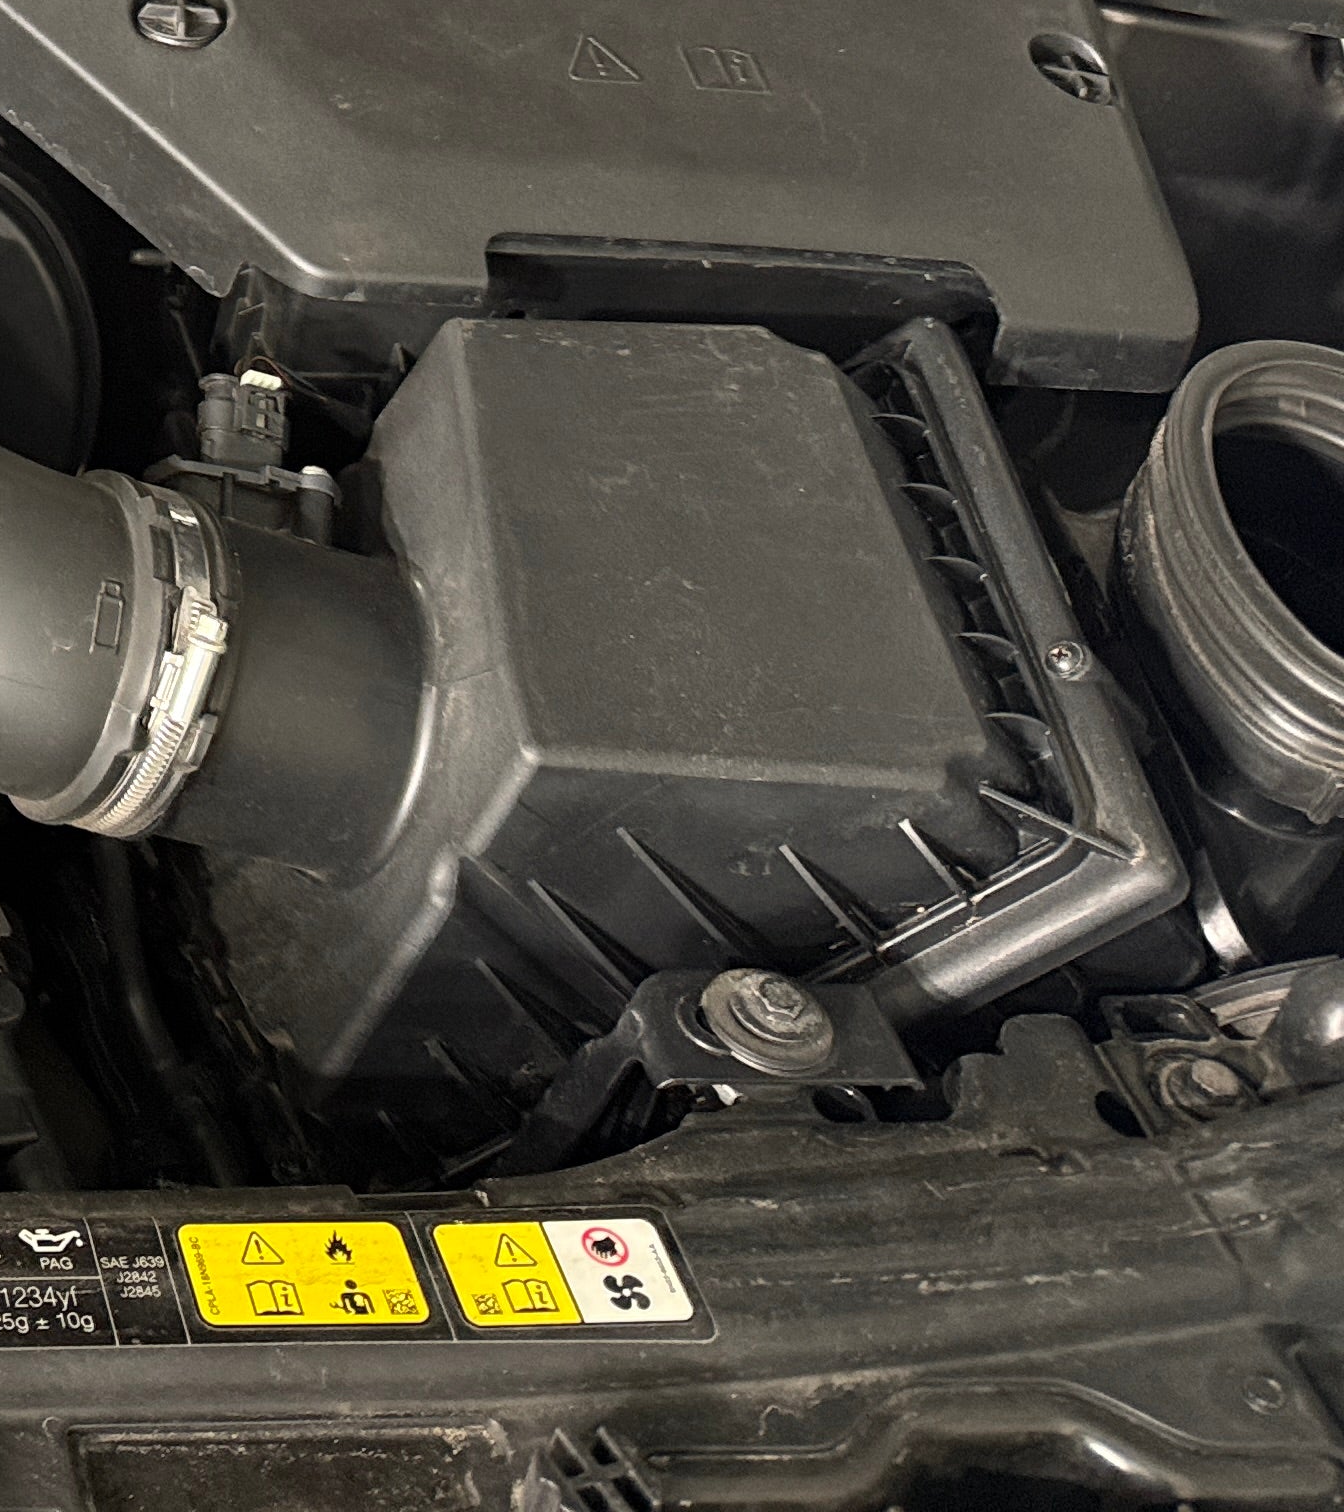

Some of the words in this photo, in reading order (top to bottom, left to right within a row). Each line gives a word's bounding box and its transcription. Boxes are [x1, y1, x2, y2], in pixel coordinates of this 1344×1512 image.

[39, 1257, 74, 1270] PAG
[100, 1257, 128, 1269] SAE
[132, 1256, 165, 1269] J639
[116, 1271, 158, 1284] J2842
[120, 1285, 162, 1298] J2845
[56, 1312, 95, 1333] 10g
